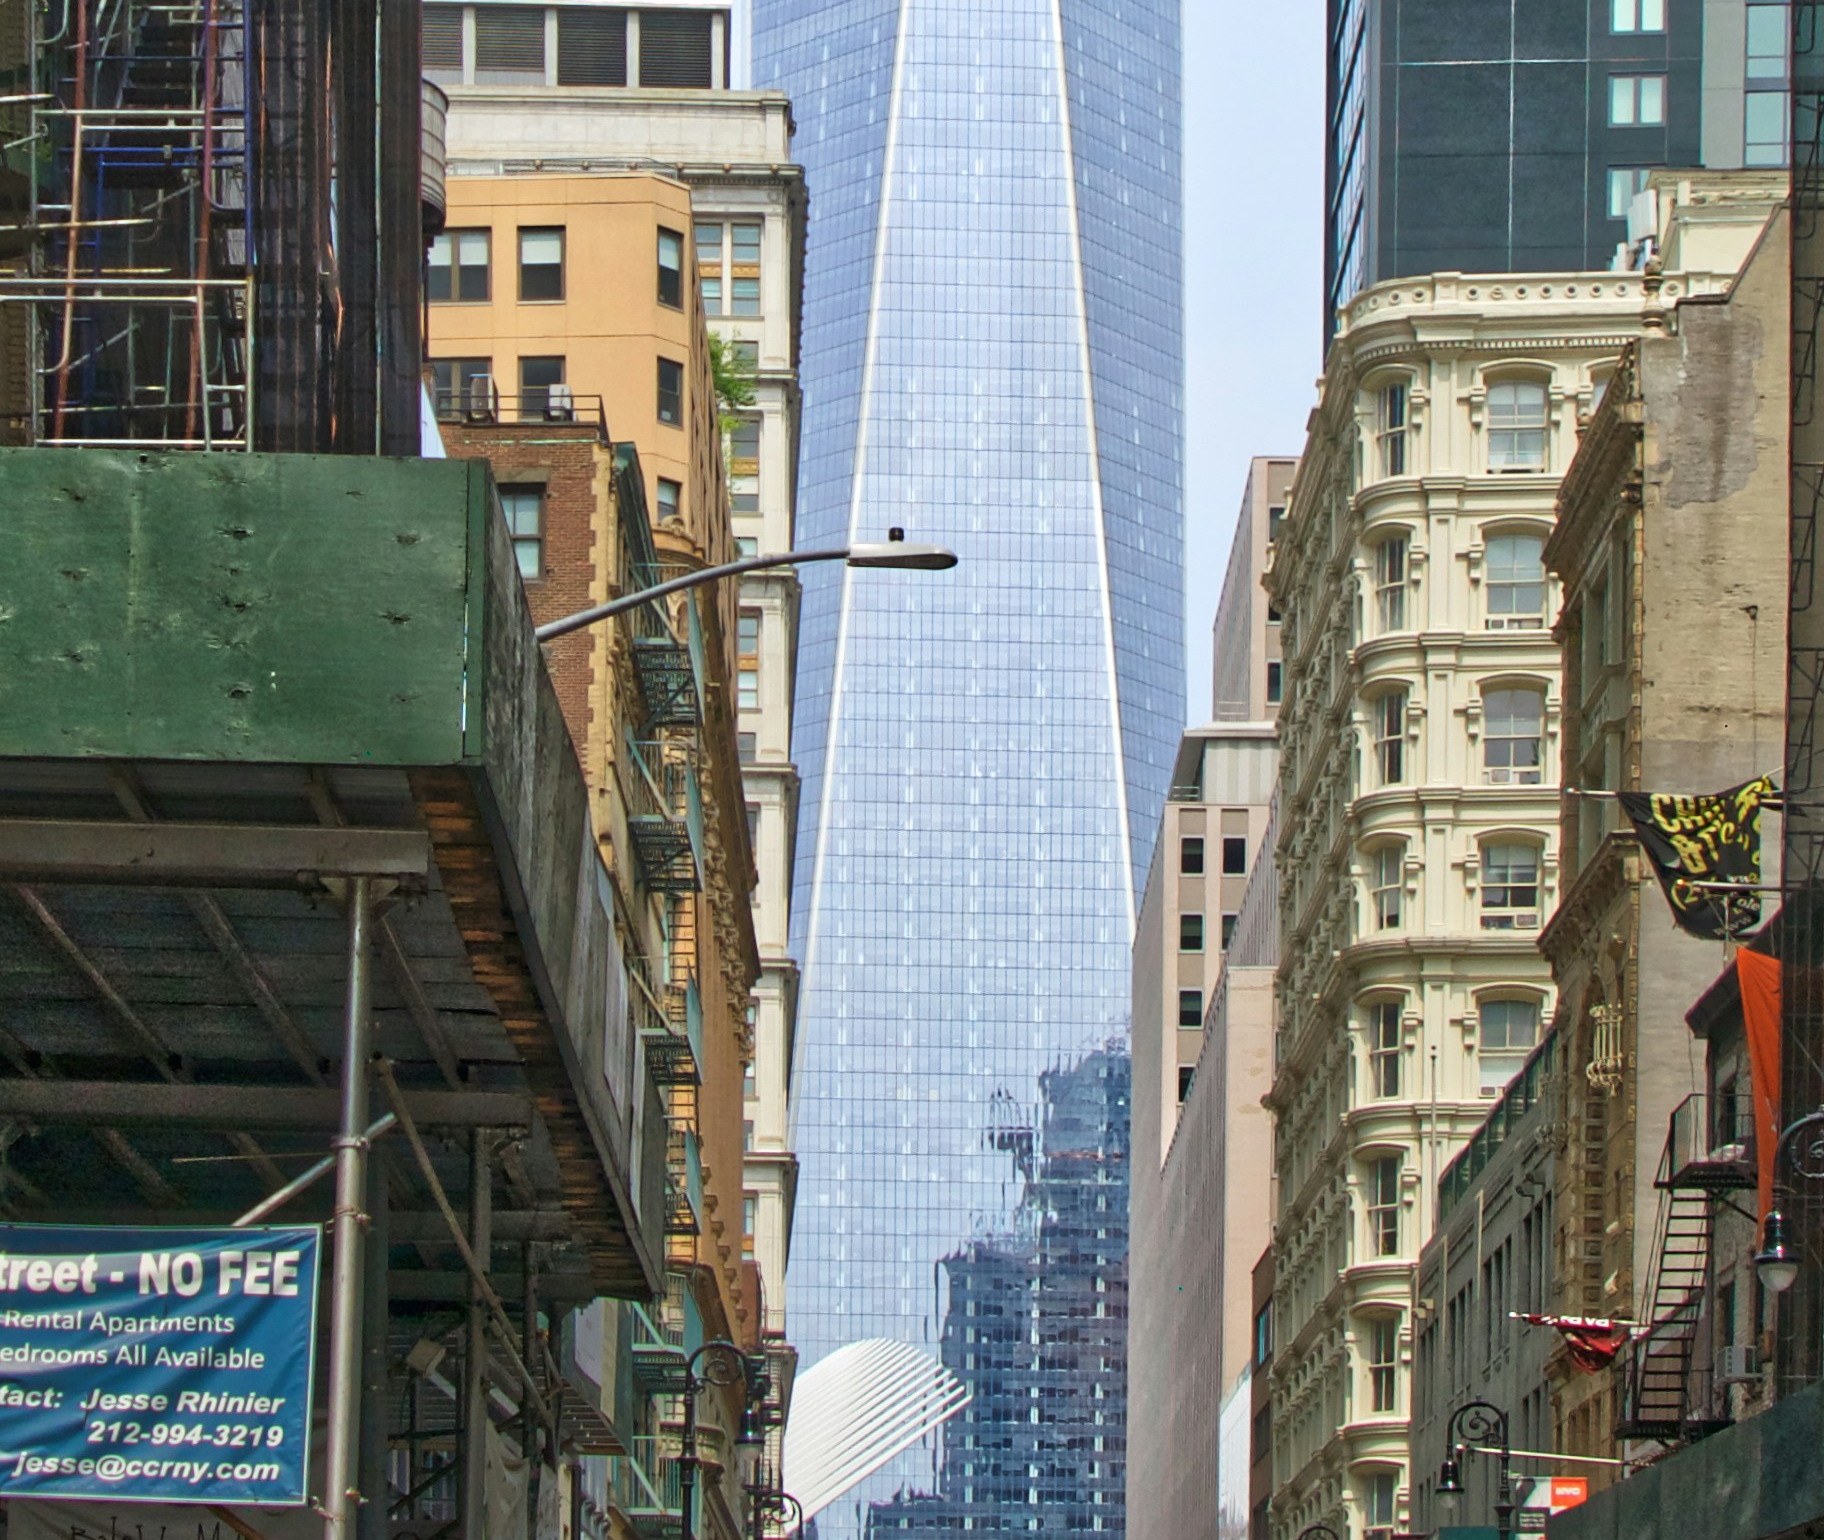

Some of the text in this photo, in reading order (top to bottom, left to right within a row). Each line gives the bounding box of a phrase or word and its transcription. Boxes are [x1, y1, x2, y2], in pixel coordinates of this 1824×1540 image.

[138, 1251, 204, 1297] NO
[217, 1249, 301, 1297] FEE
[3, 1309, 83, 1331] Rental
[88, 1310, 236, 1337] Apartments
[114, 1344, 147, 1366] All
[153, 1346, 266, 1370] Available
[80, 1388, 169, 1412] Jesse
[176, 1390, 286, 1415] Rhinier
[87, 1420, 284, 1448] 212-994-3219
[10, 1451, 280, 1483] jesse@ccrny.com
